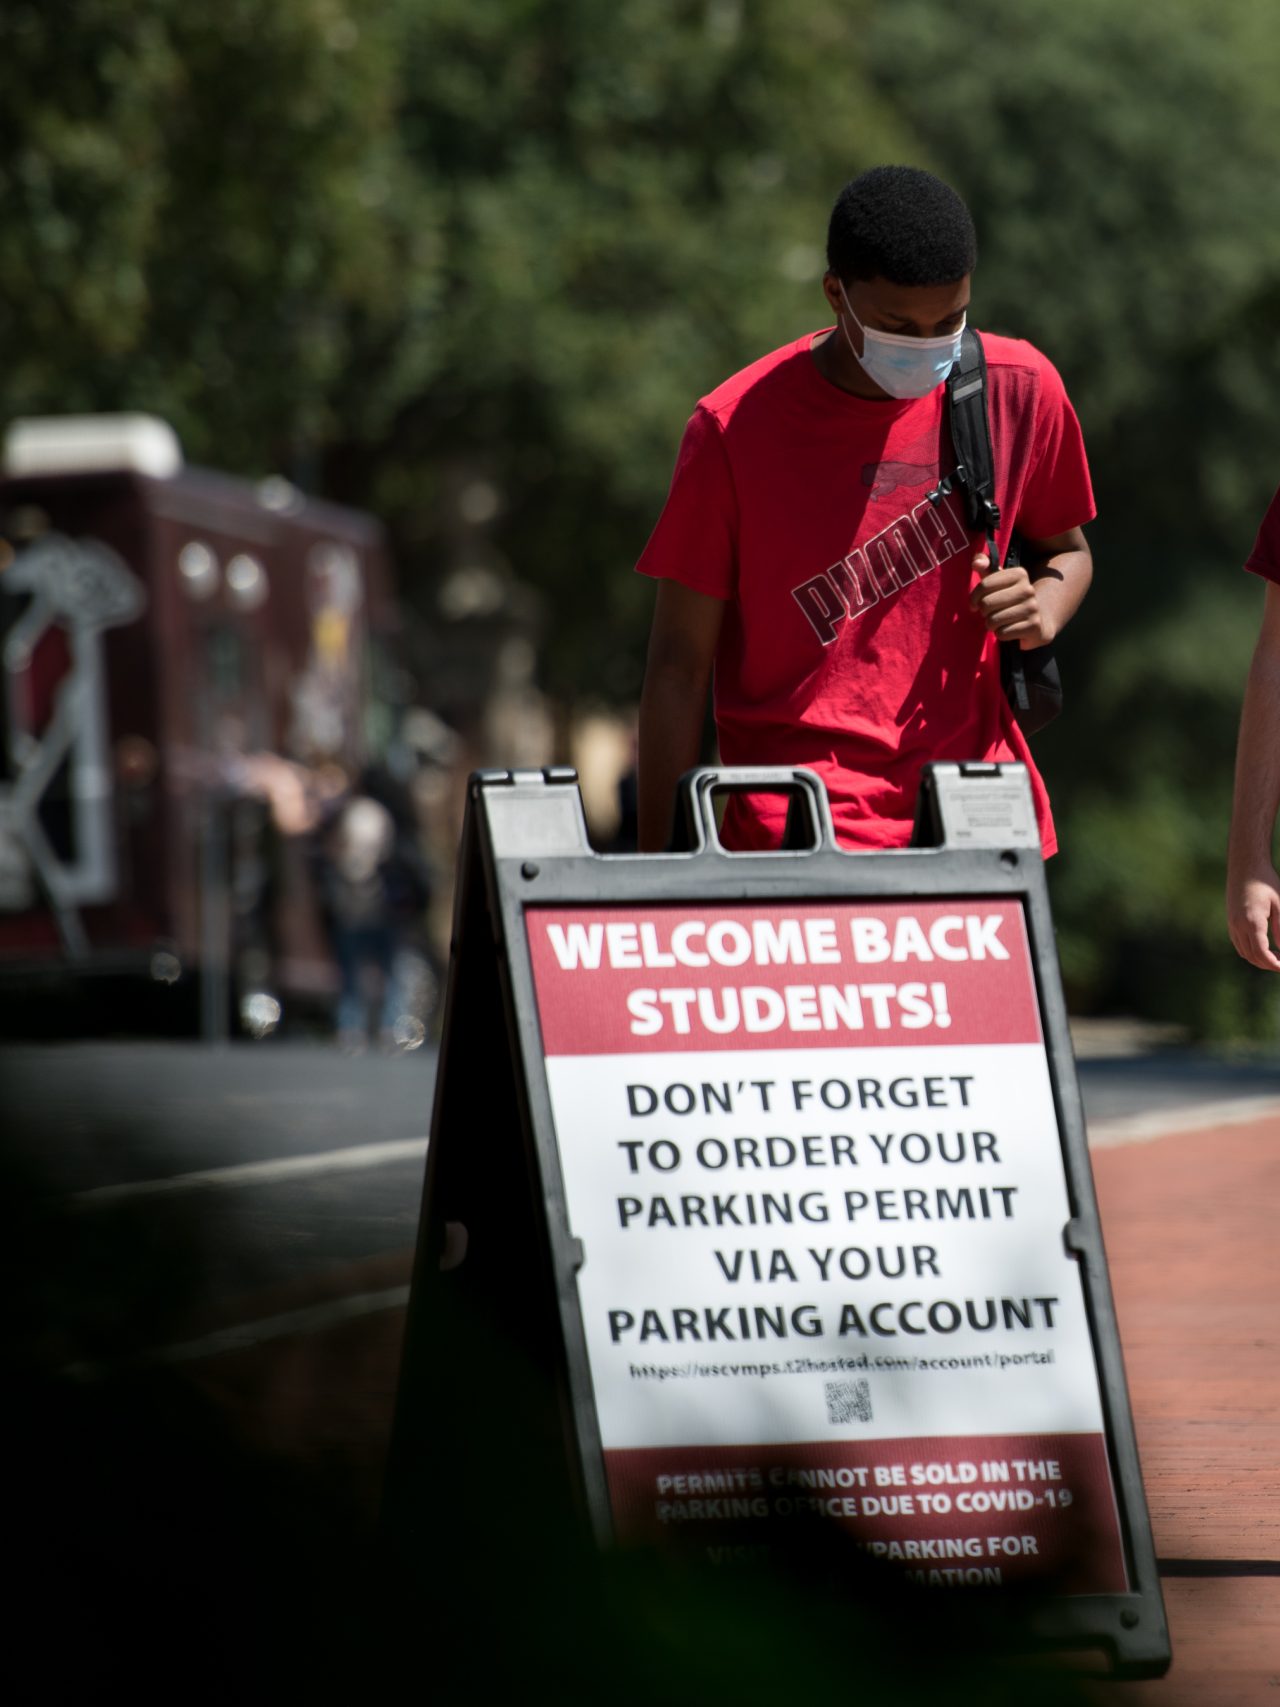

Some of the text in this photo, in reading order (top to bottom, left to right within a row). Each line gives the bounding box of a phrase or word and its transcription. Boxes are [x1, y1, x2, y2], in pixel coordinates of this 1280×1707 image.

[791, 497, 970, 646] PUMA
[547, 914, 1010, 970] WELCOME BACK
[626, 982, 952, 1036] STUDENTS!
[626, 1075, 976, 1118] DON'T FORGET
[618, 1131, 1002, 1173] TO ORDER YOUR
[616, 1186, 1018, 1228] PARKING PERMIT
[715, 1245, 942, 1283] VIA YOUR
[608, 1297, 1060, 1344] PARKING ACCOUNT
[656, 1469, 764, 1496] PERMITS
[874, 1464, 906, 1487] BE
[911, 1462, 978, 1486] SOLD
[982, 1461, 1009, 1483] IN
[1014, 1459, 1063, 1481] THE
[656, 1498, 769, 1521] PARKING
[866, 1495, 915, 1517] DUE
[917, 1493, 951, 1515] TO
[955, 1489, 1073, 1514] COVID-19
[987, 1534, 1039, 1557] FOR
